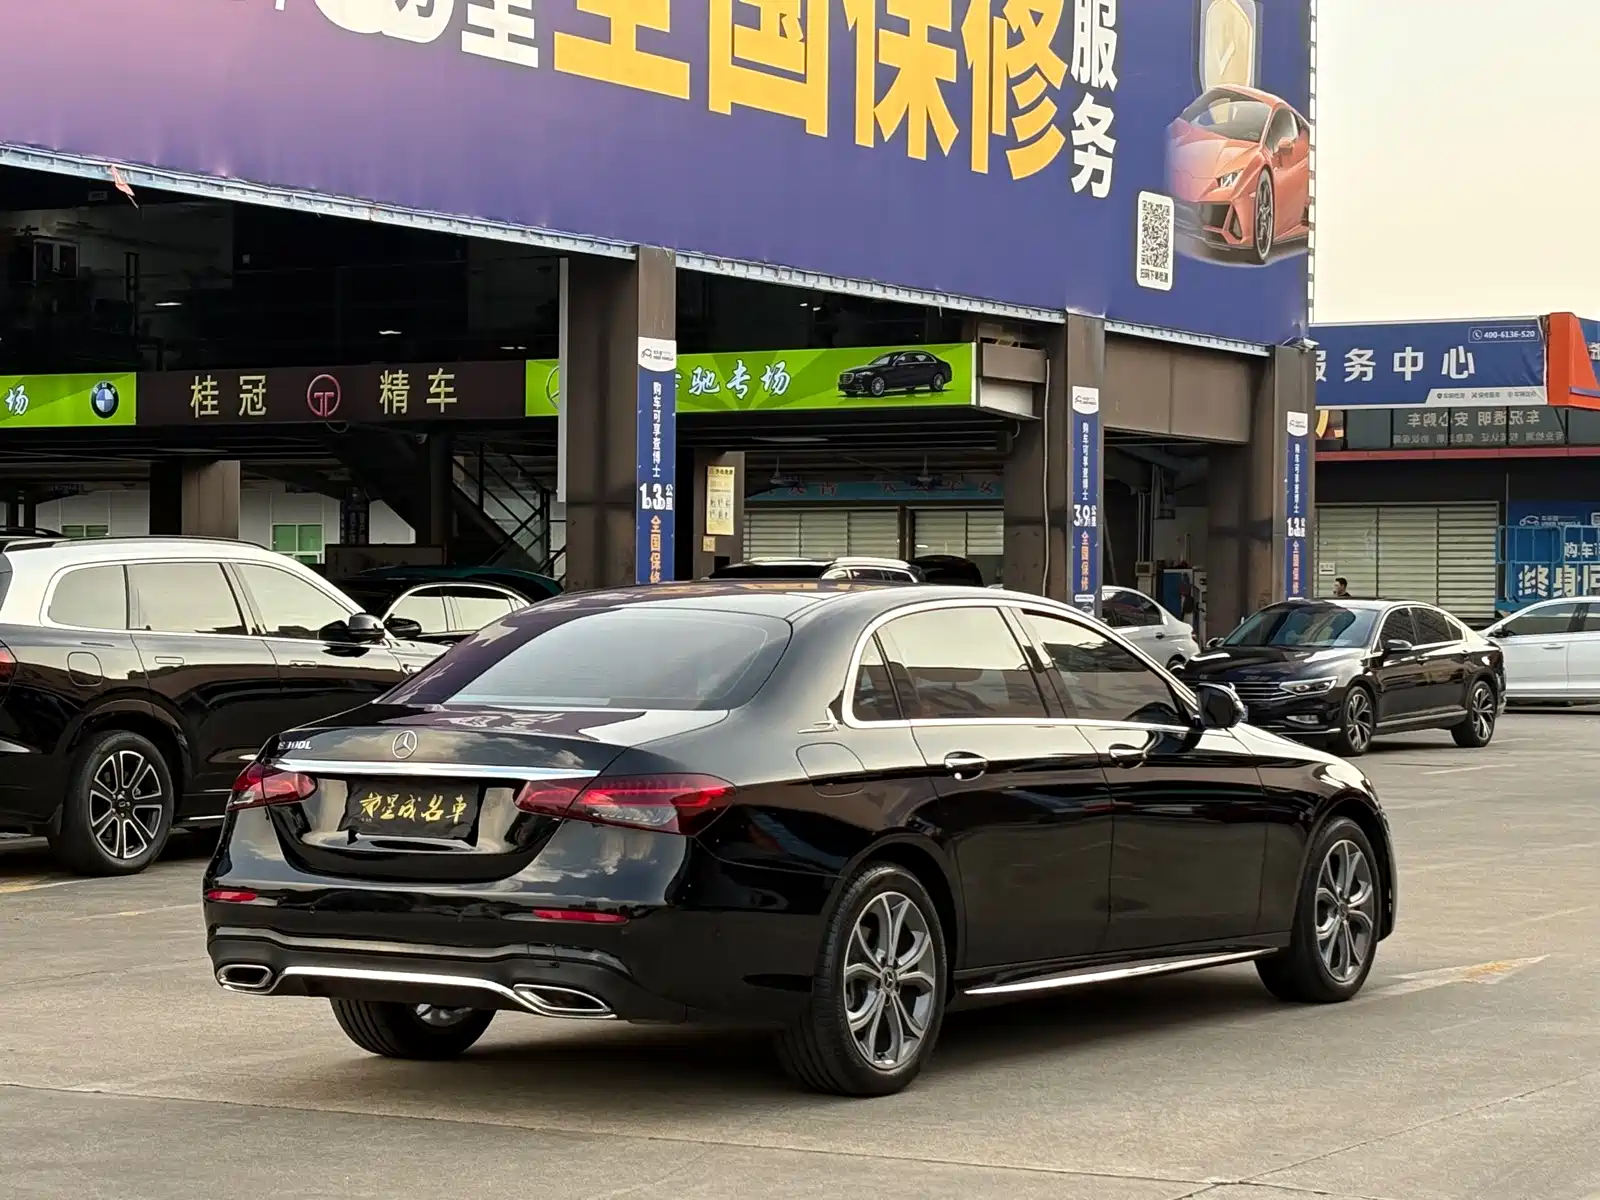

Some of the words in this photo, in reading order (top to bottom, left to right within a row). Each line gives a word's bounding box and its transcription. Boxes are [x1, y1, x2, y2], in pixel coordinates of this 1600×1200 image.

[1070, 0, 1119, 199] 服务
[5, 384, 29, 415] 场
[189, 375, 267, 418] 桂冠
[379, 368, 457, 414] 精车
[676, 359, 791, 400] 驰专场
[1564, 541, 1600, 558] 购车
